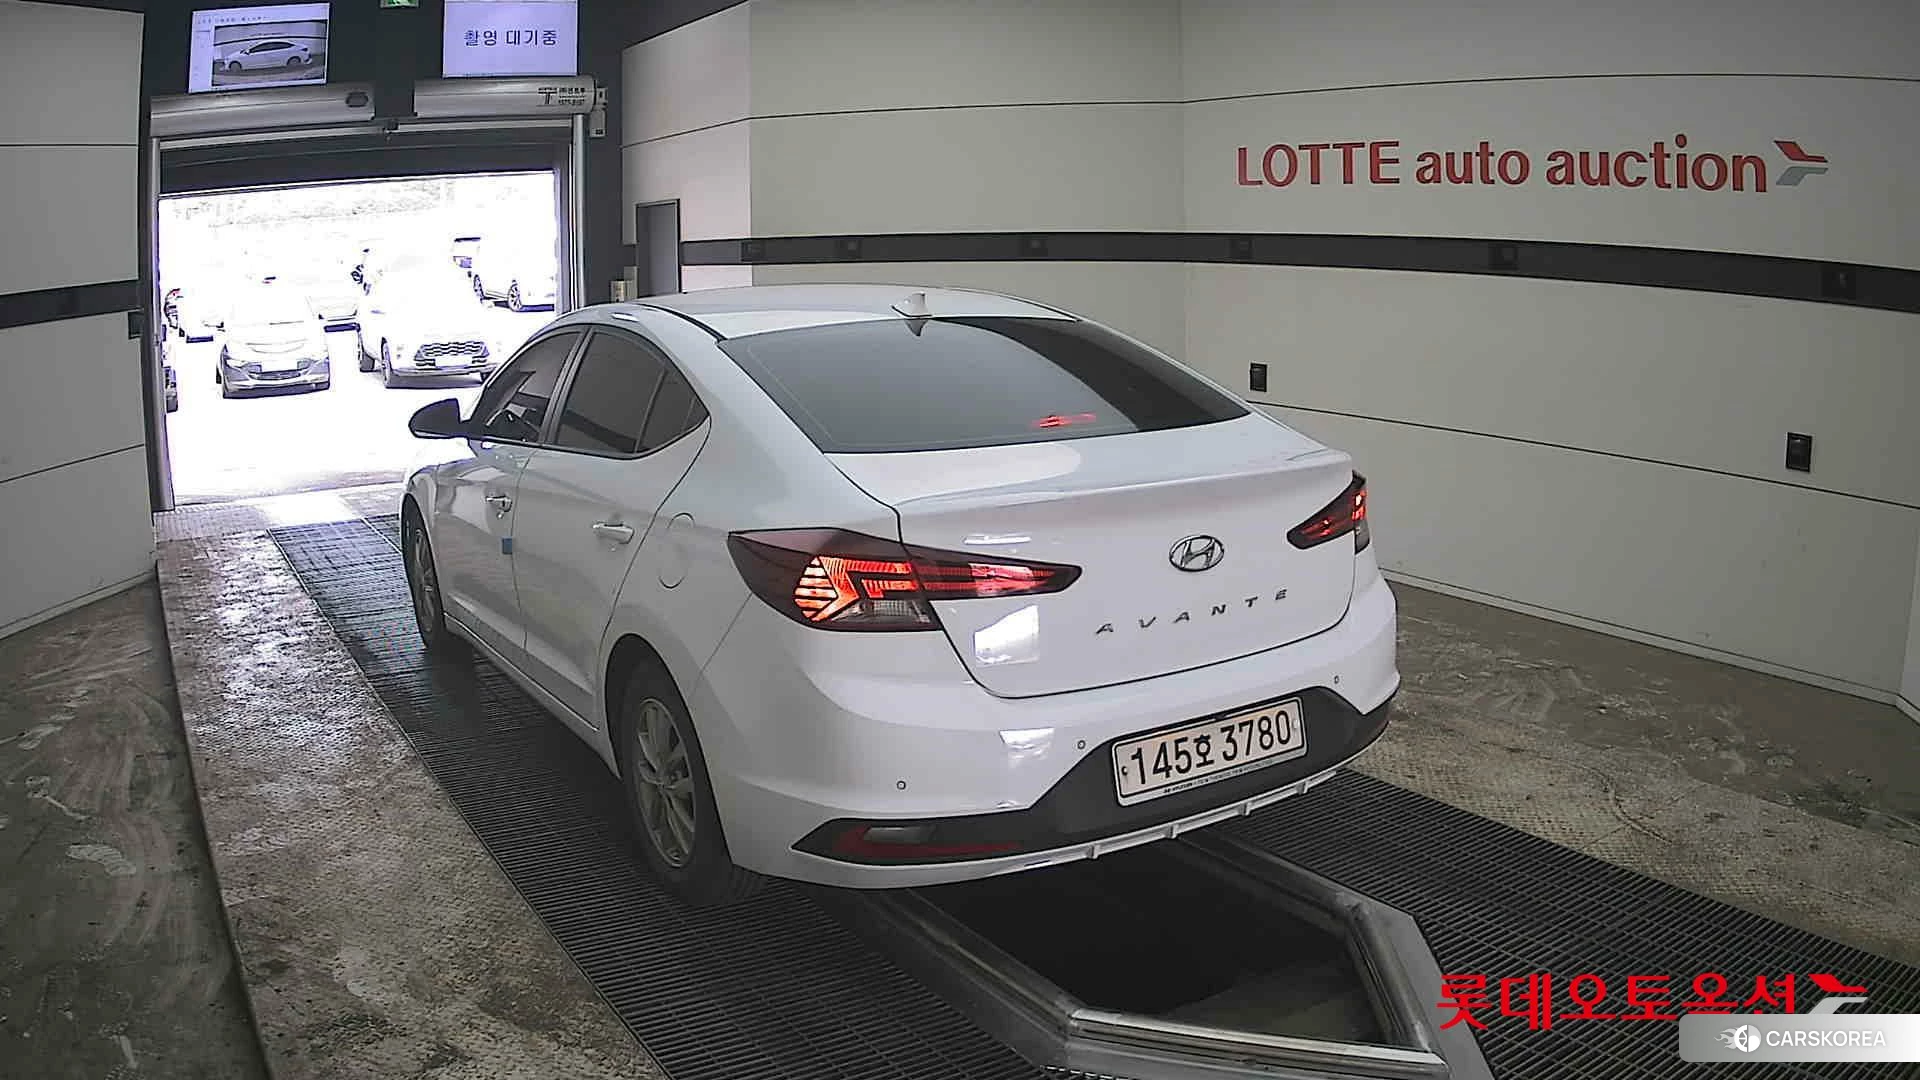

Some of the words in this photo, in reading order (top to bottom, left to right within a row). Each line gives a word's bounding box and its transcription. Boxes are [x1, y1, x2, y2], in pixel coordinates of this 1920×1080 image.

[464, 29, 497, 46] 촬영
[505, 29, 557, 46] 대기중
[1237, 141, 1398, 187] LOTTE
[1416, 141, 1530, 186] auto
[1547, 134, 1767, 193] auction
[1096, 589, 1287, 634] AVANTE
[1220, 710, 1291, 762] 3780
